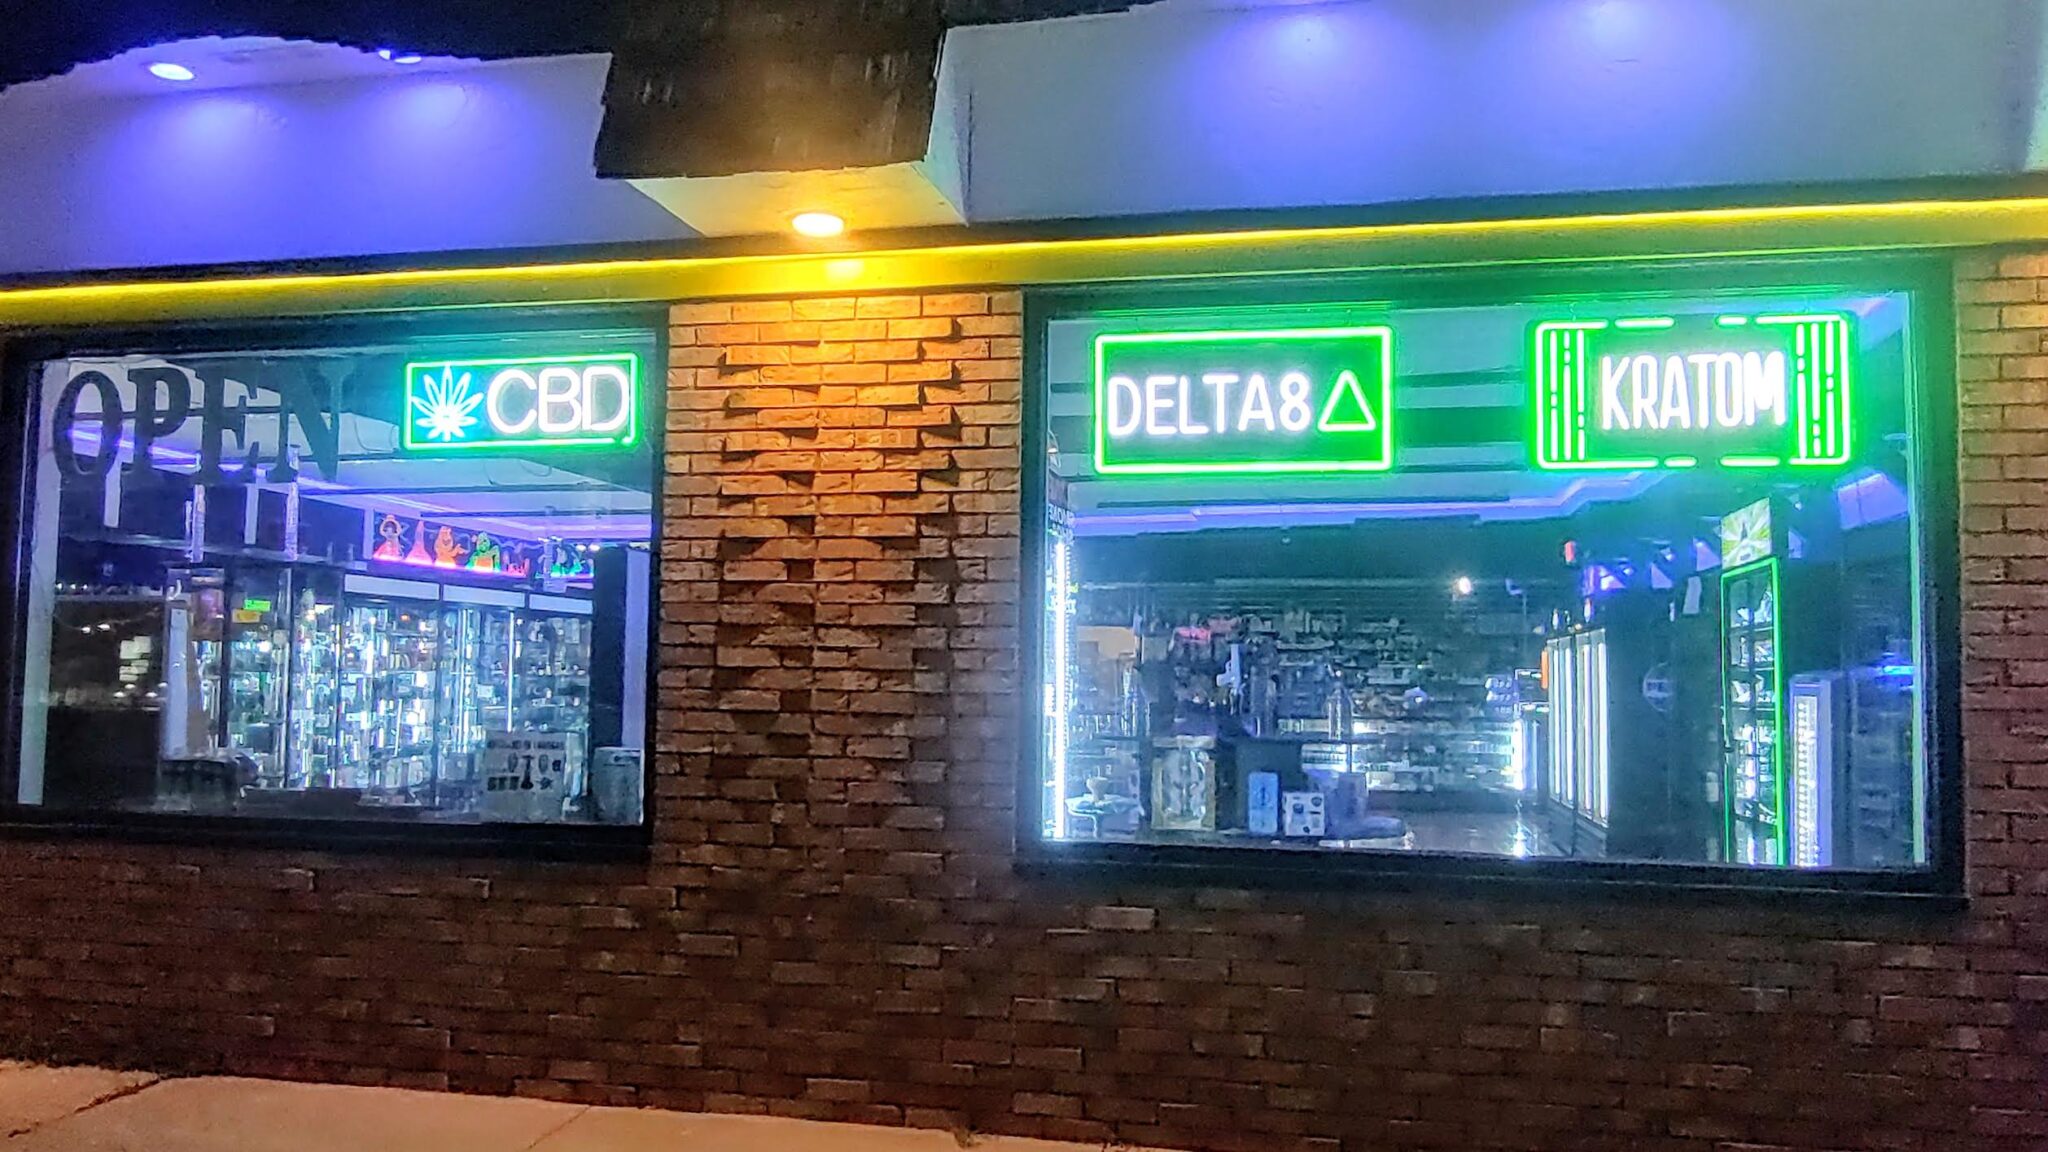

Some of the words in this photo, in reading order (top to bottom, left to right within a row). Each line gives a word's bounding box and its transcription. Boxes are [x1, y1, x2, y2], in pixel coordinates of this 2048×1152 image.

[53, 366, 348, 482] OPEN
[486, 366, 629, 433] CBD
[1107, 373, 1312, 437] DELTA8
[1601, 351, 1786, 430] KRATOM
